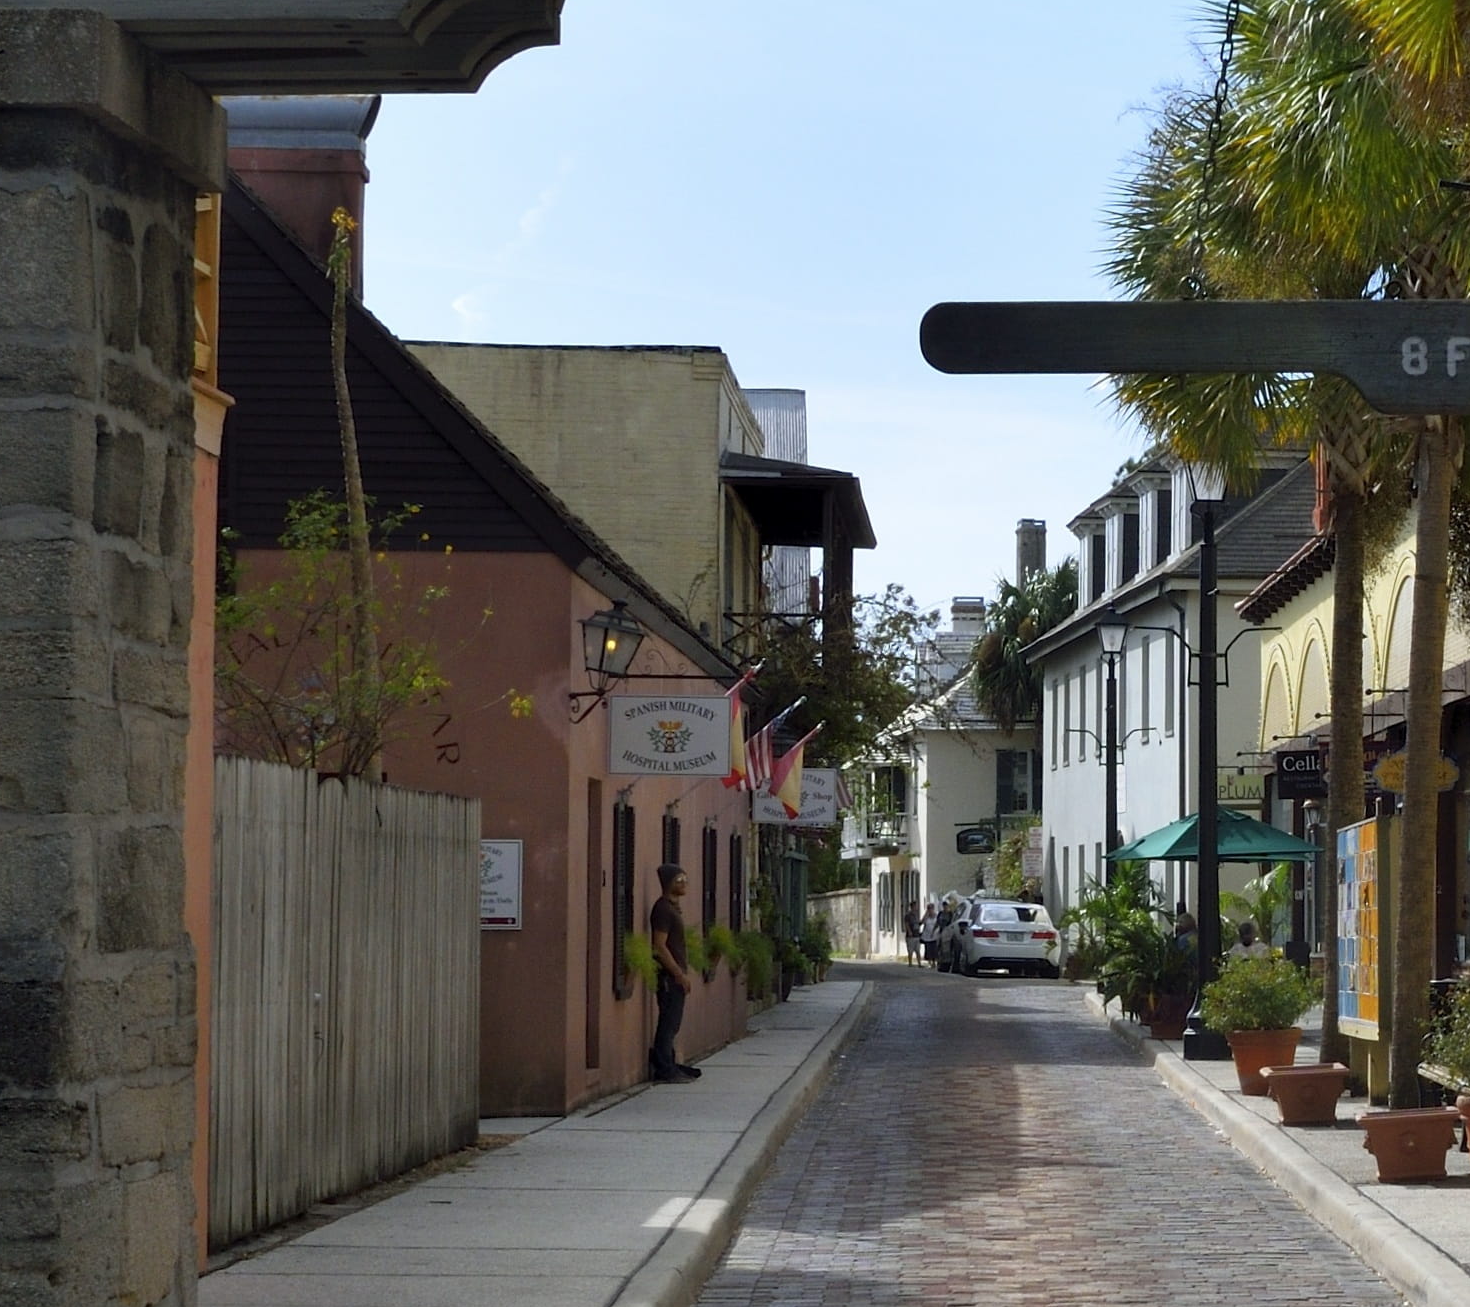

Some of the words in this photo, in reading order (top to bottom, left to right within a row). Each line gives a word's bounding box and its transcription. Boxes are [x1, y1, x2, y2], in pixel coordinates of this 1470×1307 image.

[625, 701, 667, 720] SPANISH
[669, 701, 716, 721] MILITARY
[622, 750, 671, 772] HOSPITAL
[673, 751, 717, 771] MUSEUM
[1218, 784, 1261, 799] PLUM
